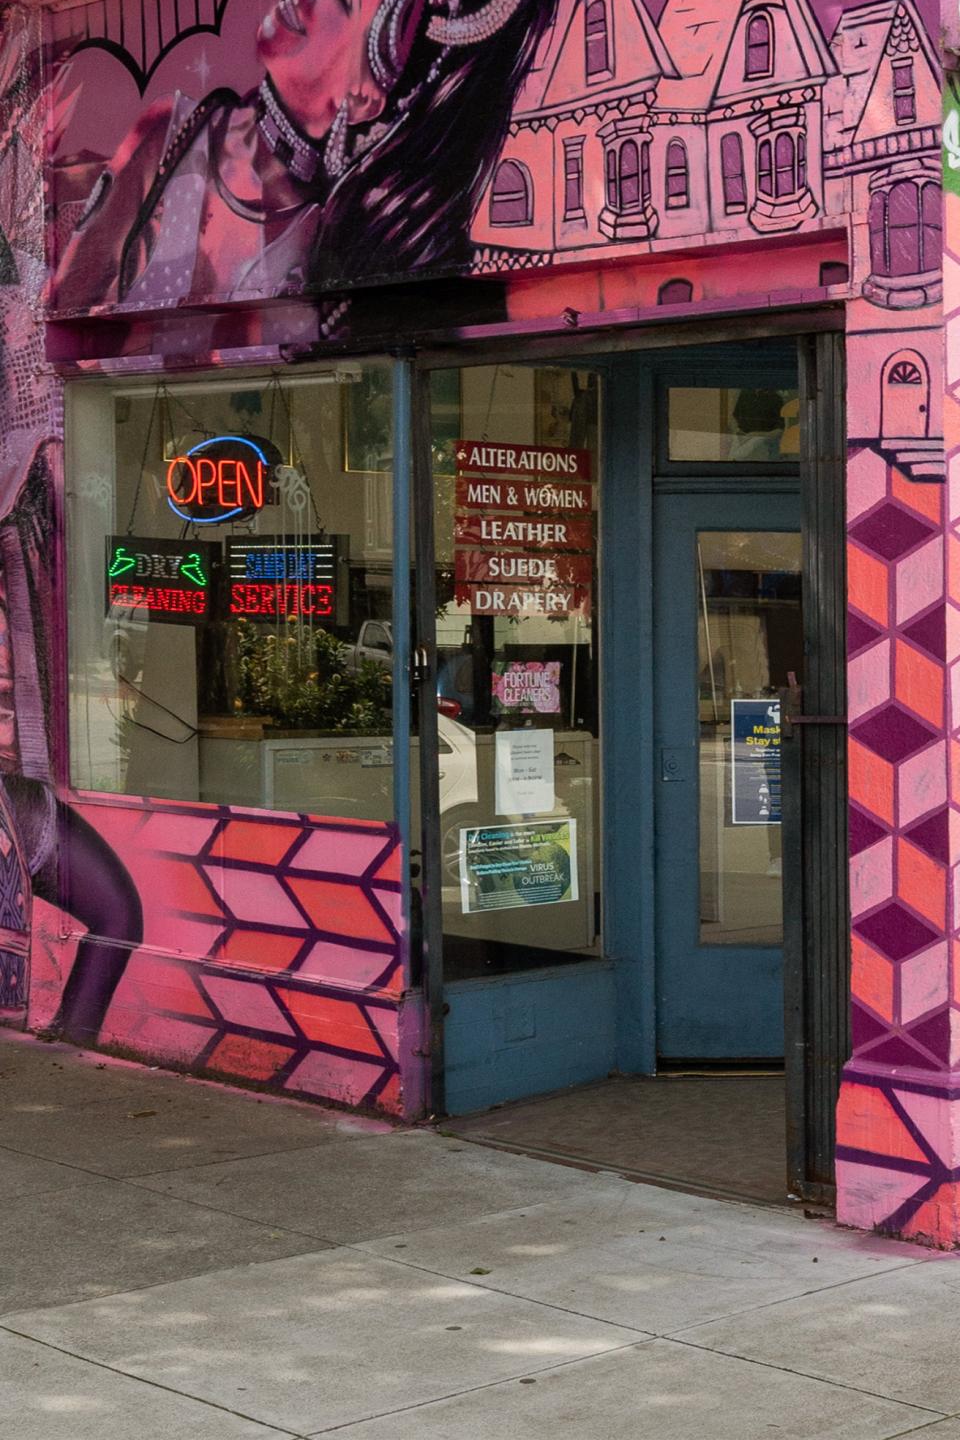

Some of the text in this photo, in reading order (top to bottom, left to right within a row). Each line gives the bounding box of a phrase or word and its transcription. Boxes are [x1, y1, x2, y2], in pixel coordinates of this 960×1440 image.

[468, 446, 579, 474] ALTERATIONS
[166, 456, 264, 508] OPEN
[467, 484, 584, 509] MEN & WOMEN
[480, 520, 568, 543] LEATHER
[134, 553, 184, 580] DRY
[488, 557, 558, 579] SUEDE
[110, 584, 207, 615] CLEANING
[230, 584, 333, 616] SERVICE
[475, 590, 573, 612] DRAPERY
[503, 671, 551, 689] FORTUNE
[503, 688, 552, 702] CLEANERS
[745, 736, 770, 747] Stay
[529, 862, 555, 872] VIRUS
[521, 872, 565, 886] OUTBREAK
